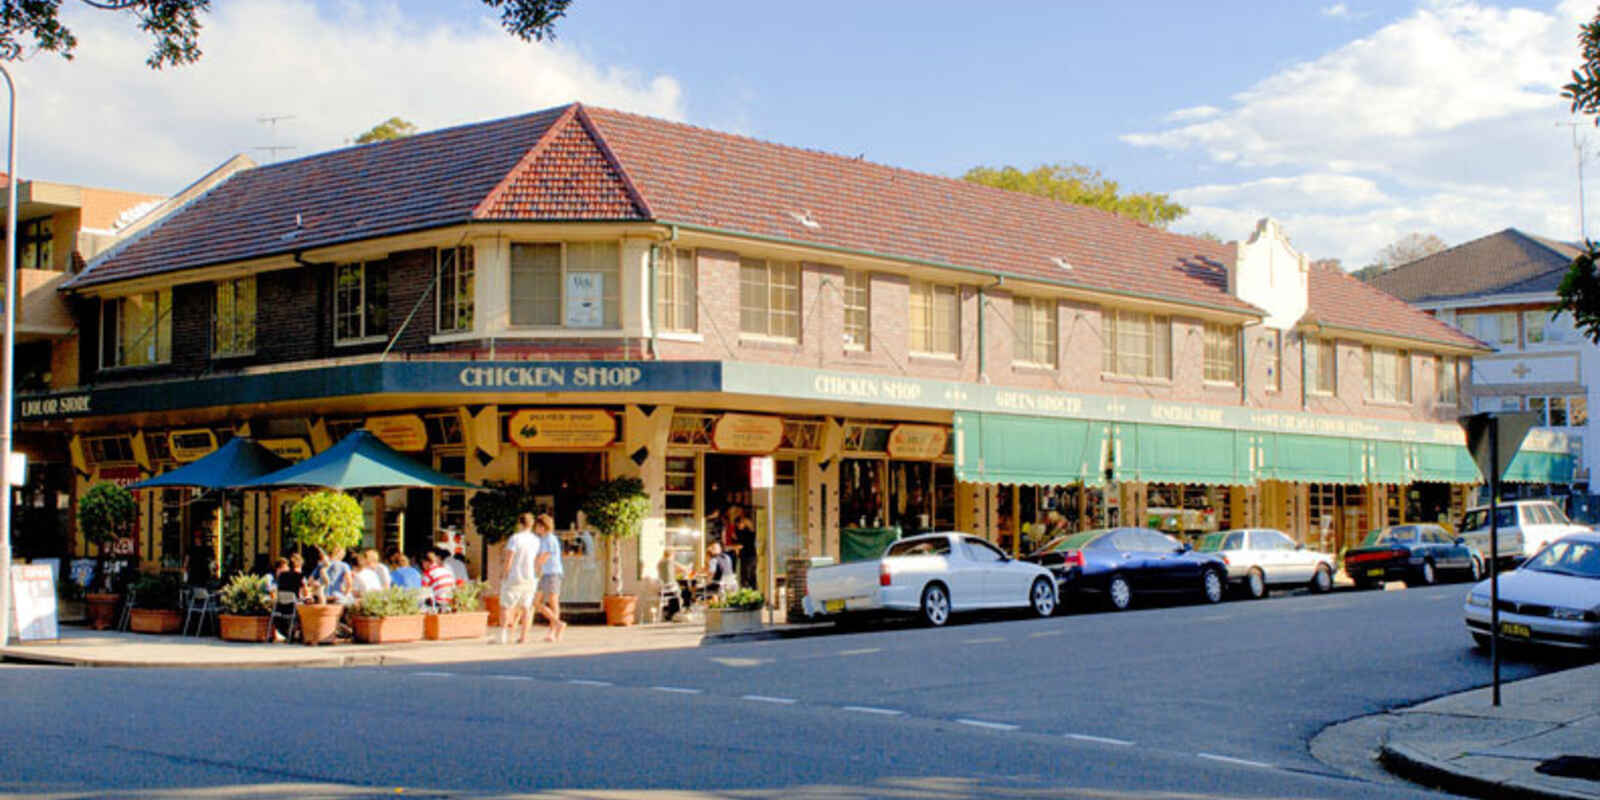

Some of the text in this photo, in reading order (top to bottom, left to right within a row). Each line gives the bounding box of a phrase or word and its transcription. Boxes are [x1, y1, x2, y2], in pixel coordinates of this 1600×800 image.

[460, 367, 642, 386] CHICKEN SHOP
[814, 374, 922, 400] CHICKEN SHOP
[22, 396, 91, 416] LIQUOR STORE
